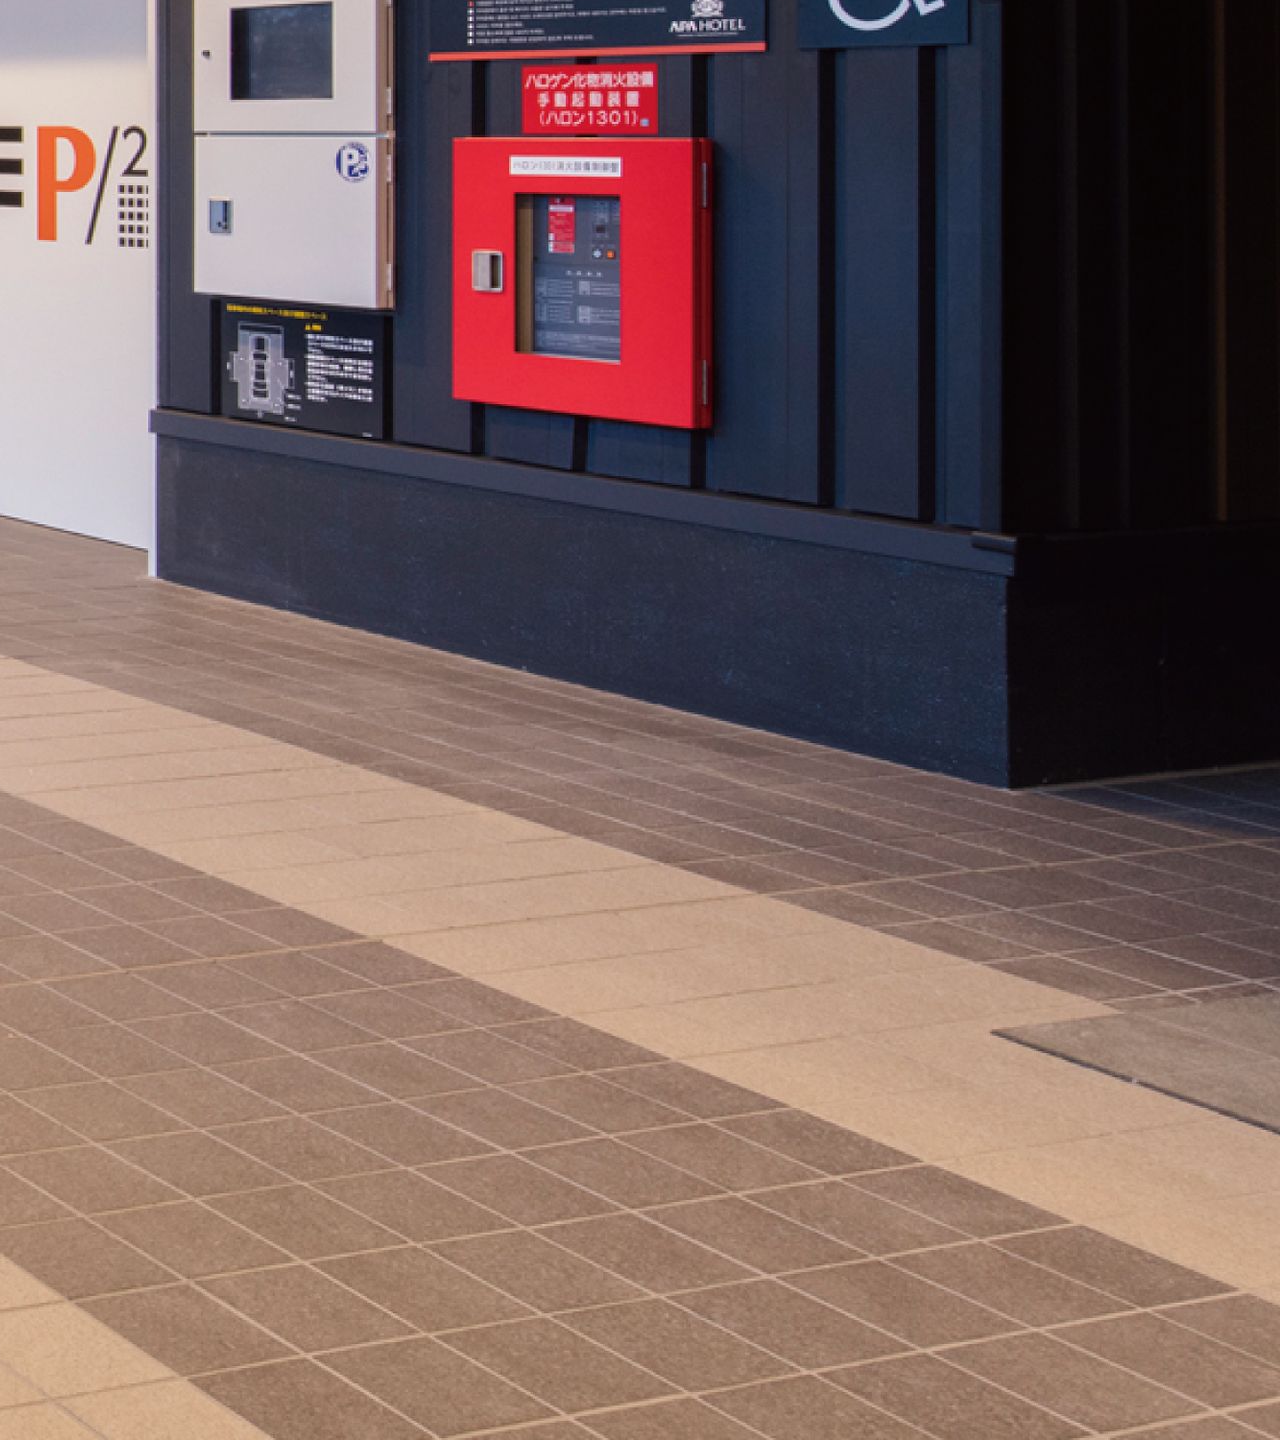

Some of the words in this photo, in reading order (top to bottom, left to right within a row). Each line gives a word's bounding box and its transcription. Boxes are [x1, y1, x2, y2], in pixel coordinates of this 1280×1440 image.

[698, 18, 747, 32] HOTEL
[524, 71, 654, 89] ハロゲン化物消火設備
